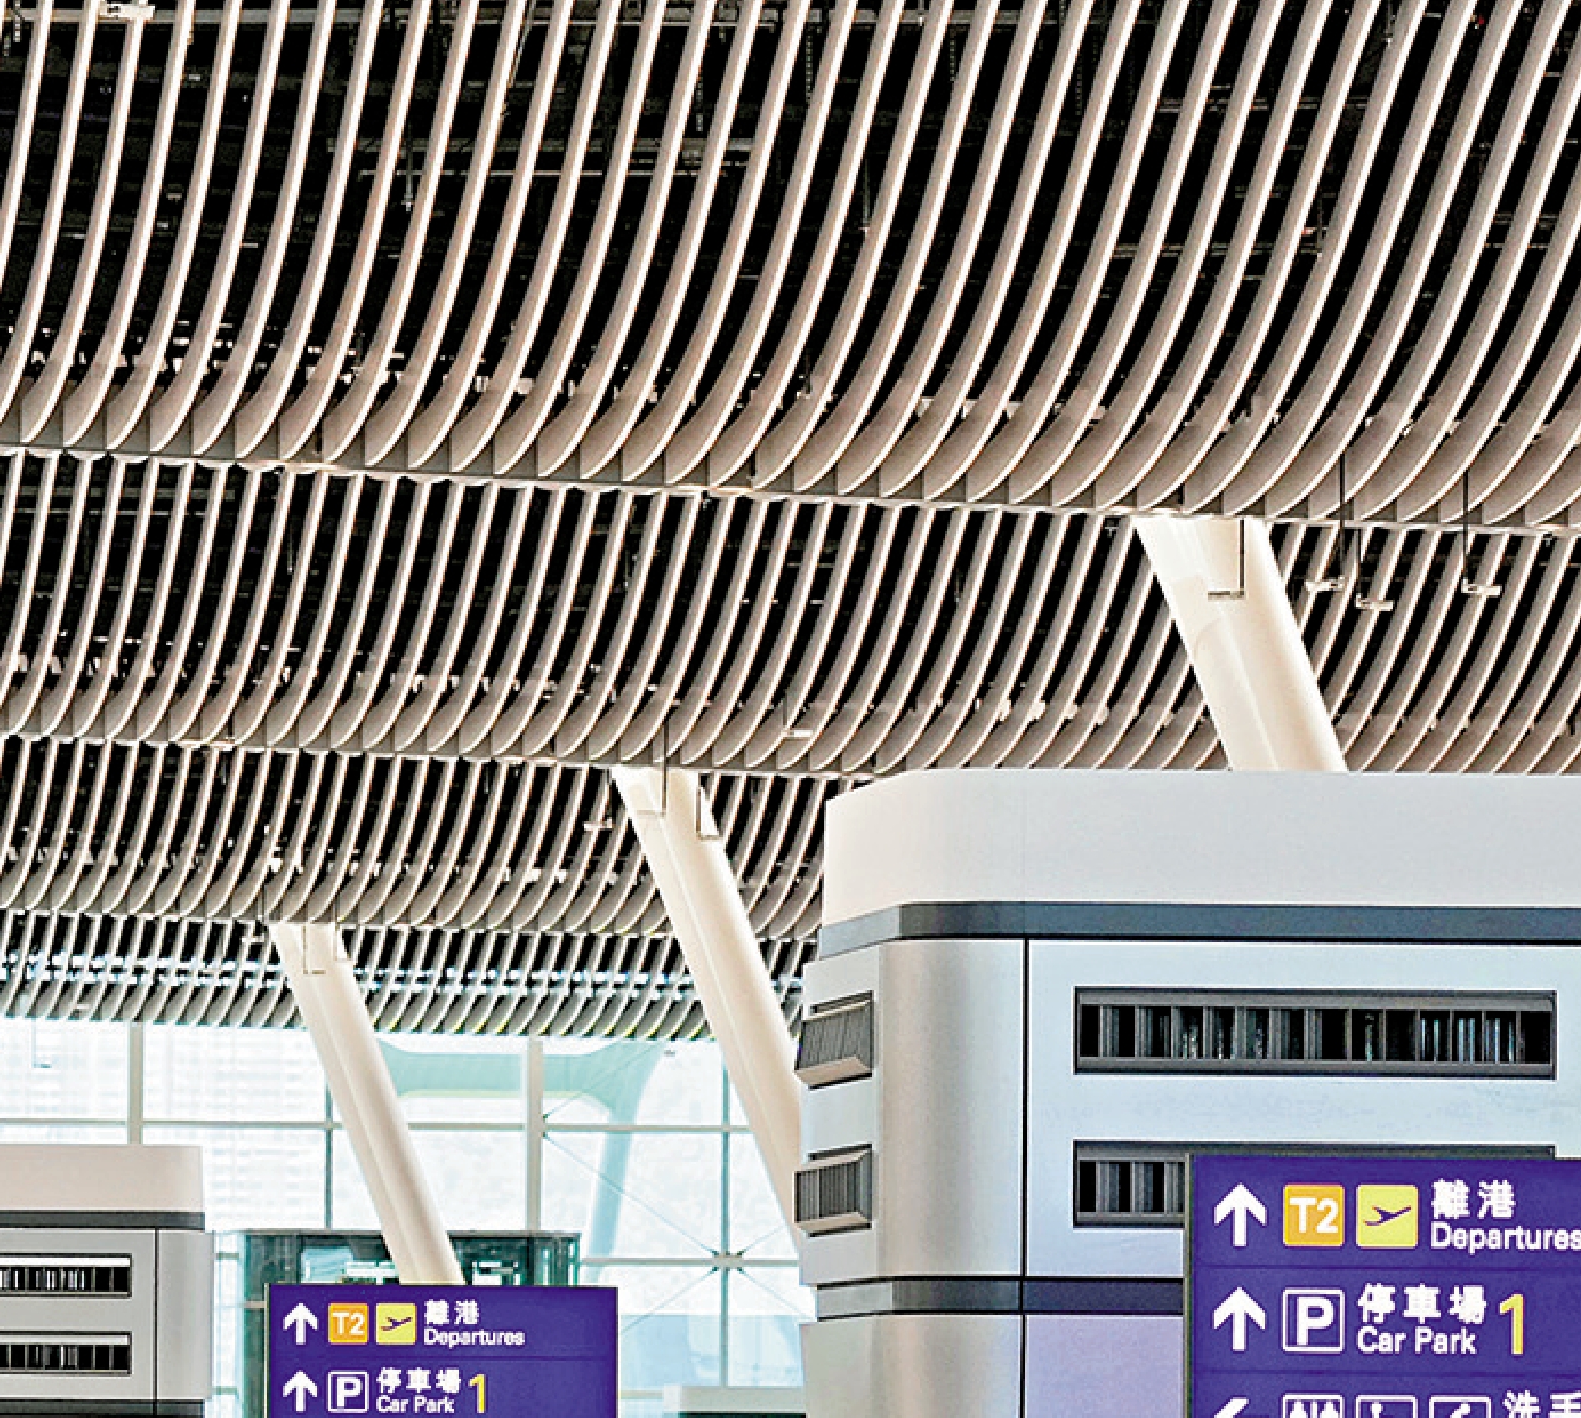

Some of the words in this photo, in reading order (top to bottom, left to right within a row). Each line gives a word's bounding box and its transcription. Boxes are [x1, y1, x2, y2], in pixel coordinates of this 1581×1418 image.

[1289, 1197, 1339, 1234] T2
[1430, 1178, 1516, 1219] 離港
[1430, 1220, 1581, 1255] Departures
[1357, 1282, 1487, 1325] 停車場
[332, 1312, 365, 1335] T2
[422, 1328, 527, 1349] Departures
[1357, 1326, 1404, 1353] Car
[1414, 1325, 1477, 1355] Park
[1499, 1293, 1525, 1355] 1
[375, 1366, 462, 1394] 停車場
[469, 1374, 487, 1413] 1
[375, 1394, 408, 1414] Car
[414, 1395, 455, 1414] Park
